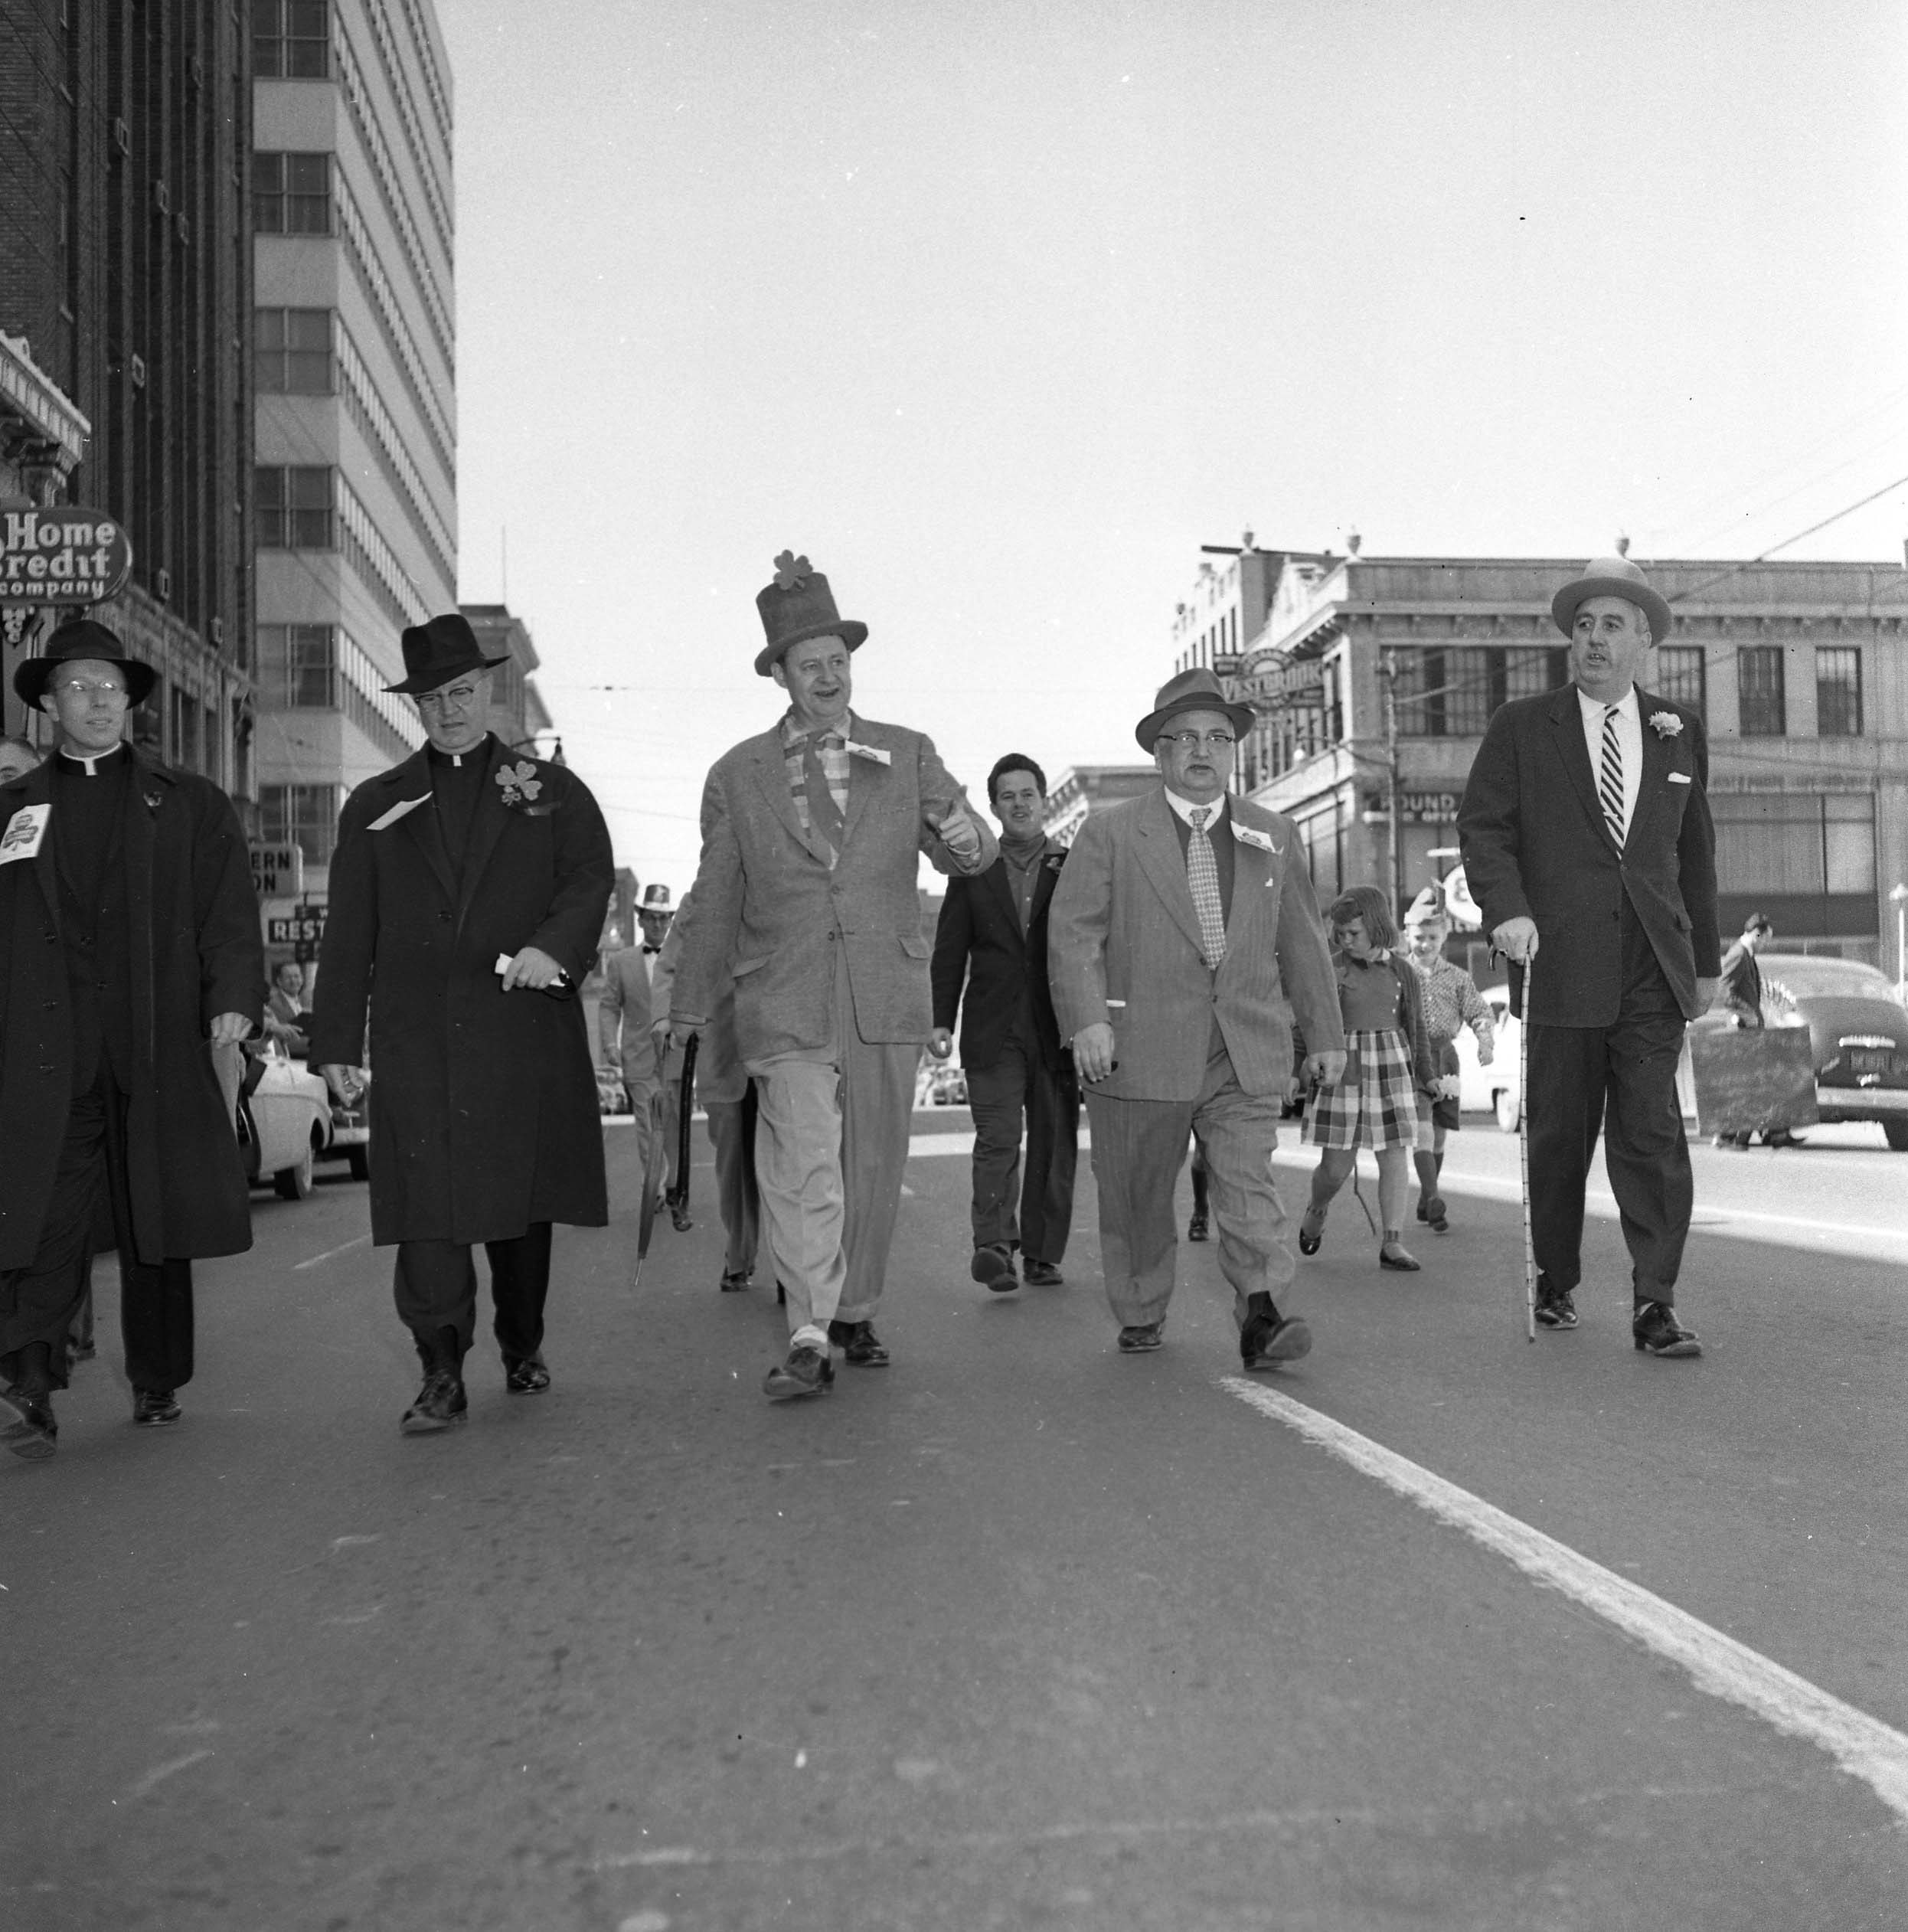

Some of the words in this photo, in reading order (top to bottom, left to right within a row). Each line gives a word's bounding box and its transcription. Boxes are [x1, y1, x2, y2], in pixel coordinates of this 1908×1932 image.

[5, 513, 115, 551] Home
[0, 542, 109, 578] redit
[0, 580, 104, 600] company
[250, 851, 290, 870] ERN
[274, 920, 325, 940] REST
